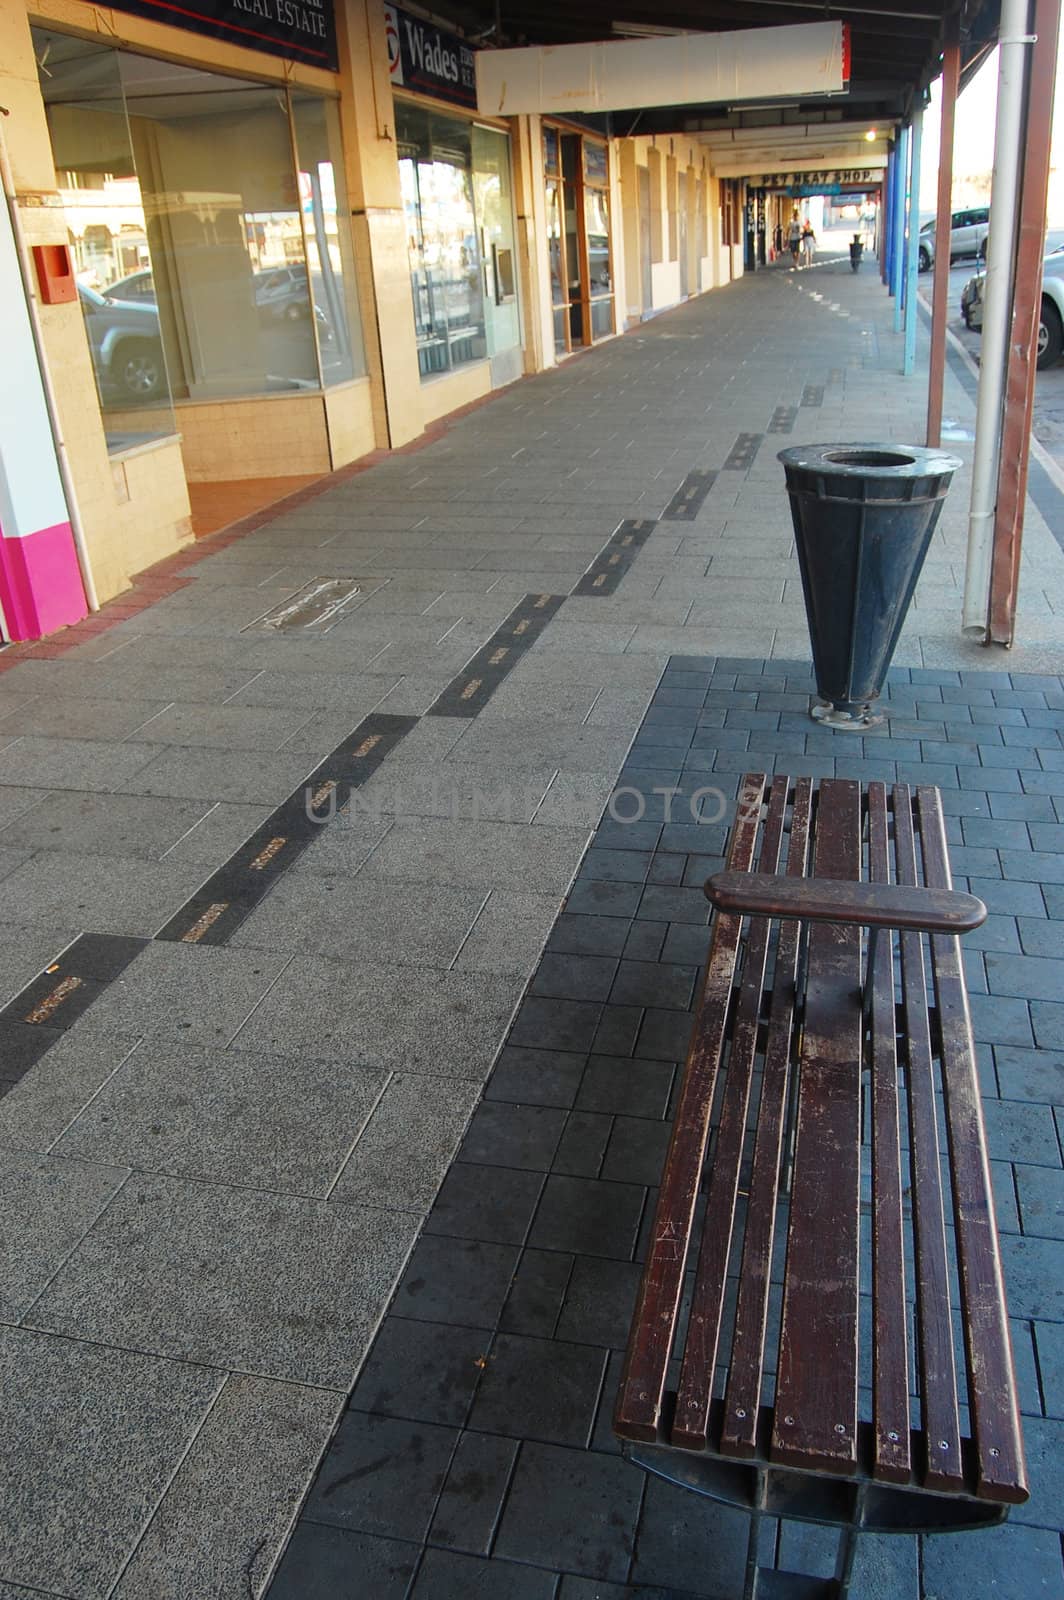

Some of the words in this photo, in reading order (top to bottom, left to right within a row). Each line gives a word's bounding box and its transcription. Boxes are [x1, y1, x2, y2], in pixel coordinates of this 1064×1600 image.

[276, 0, 327, 38] ESTATE
[404, 20, 459, 83] Wades
[762, 175, 788, 185] PET
